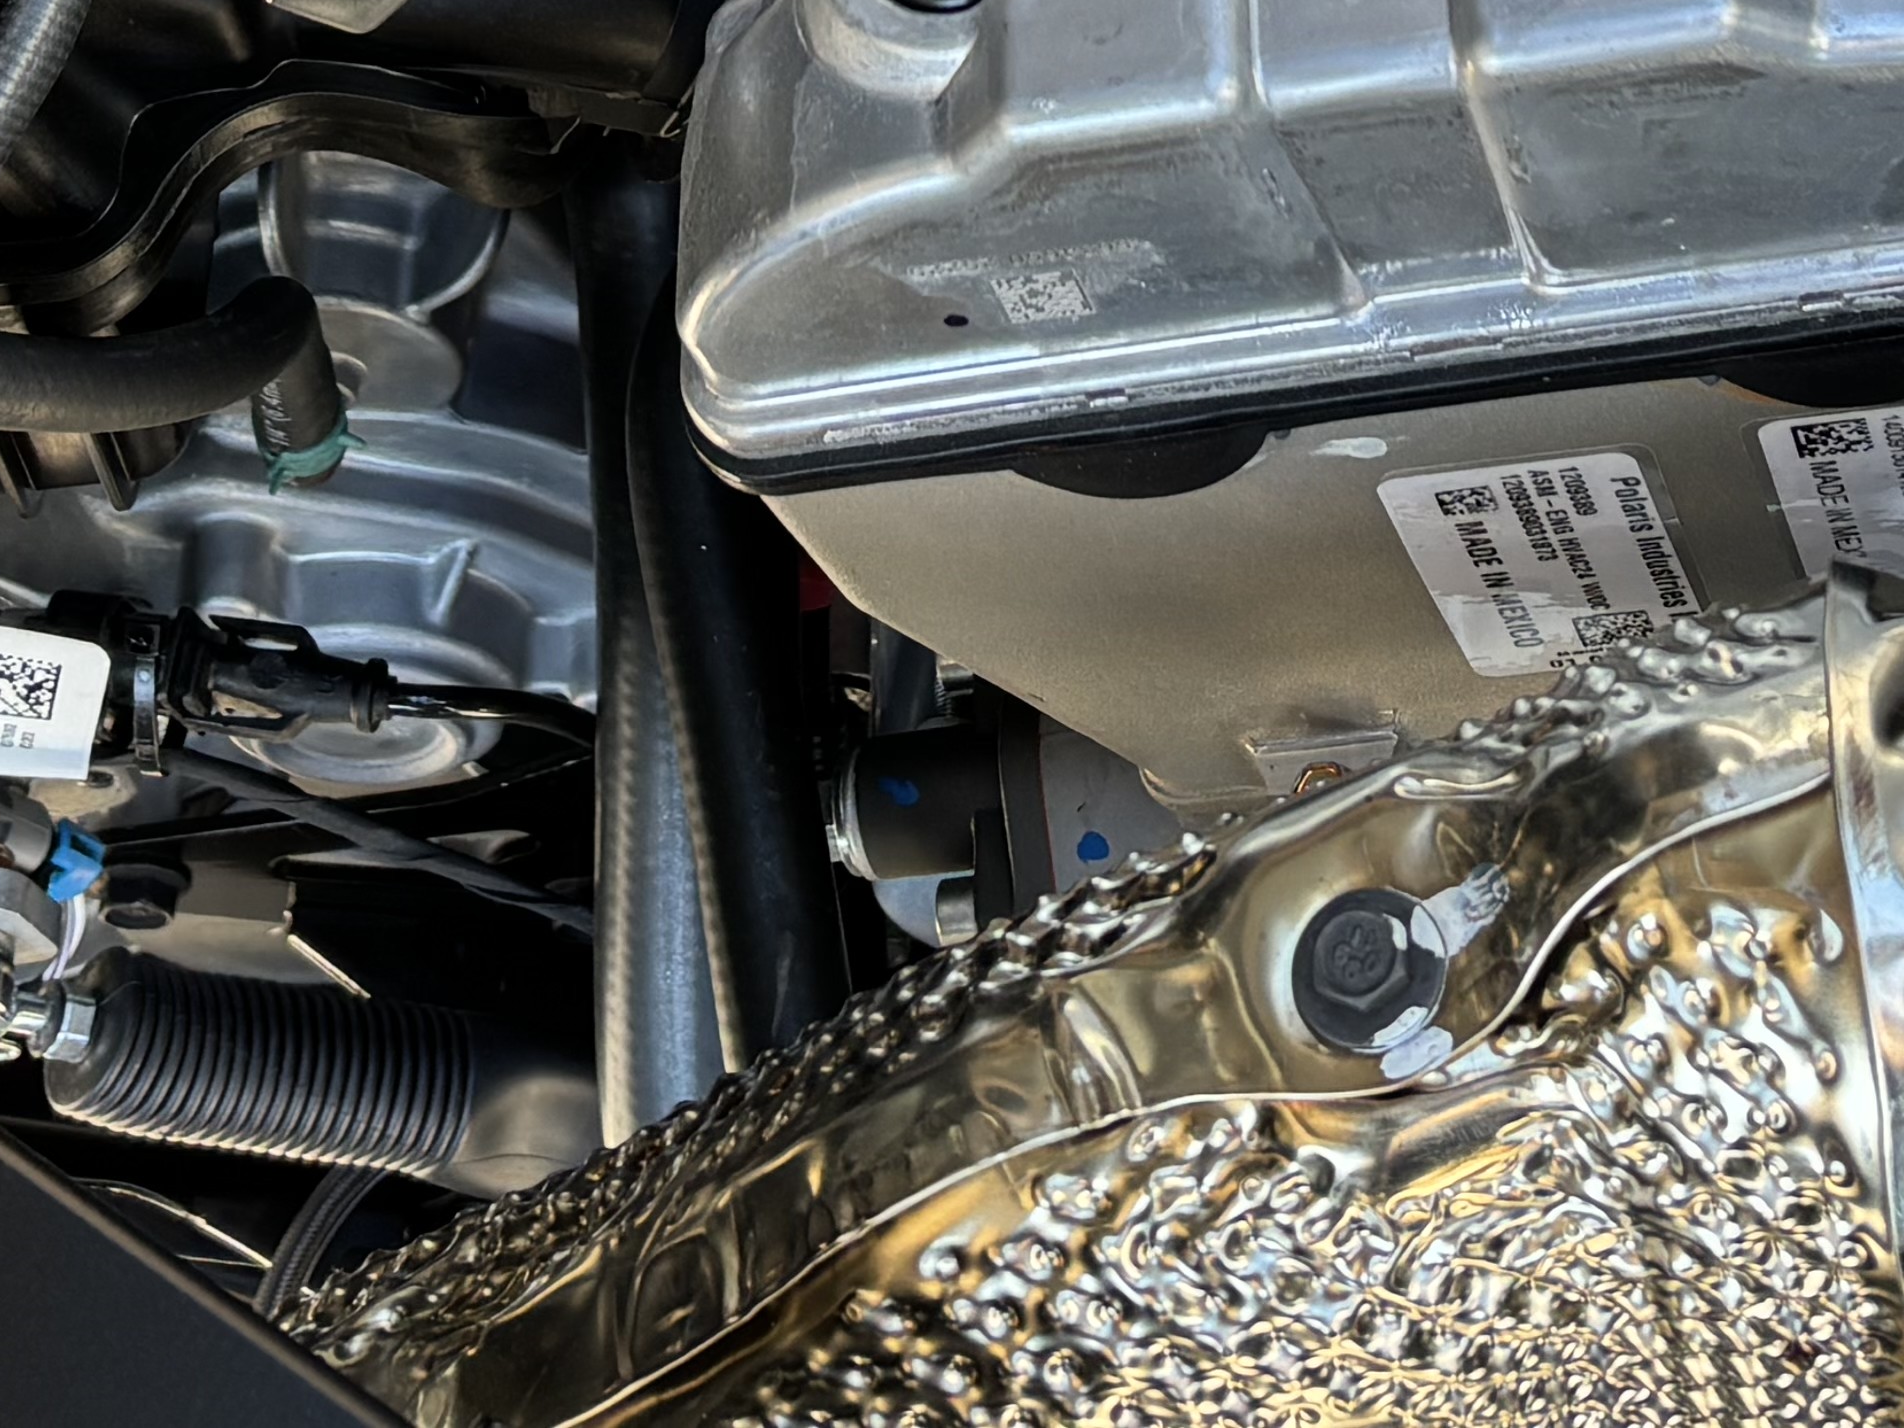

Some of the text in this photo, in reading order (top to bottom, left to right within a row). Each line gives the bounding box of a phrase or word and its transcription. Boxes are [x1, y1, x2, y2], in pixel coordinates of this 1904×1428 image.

[1527, 469, 1558, 501] ASM
[1546, 509, 1574, 535] ENG
[1558, 466, 1598, 516] 1209389
[1809, 459, 1867, 558] MADE IN MEX
[1455, 520, 1544, 649] MADE IN MEXICO
[1610, 475, 1654, 533] Polaris
[1635, 535, 1688, 610] Industries
